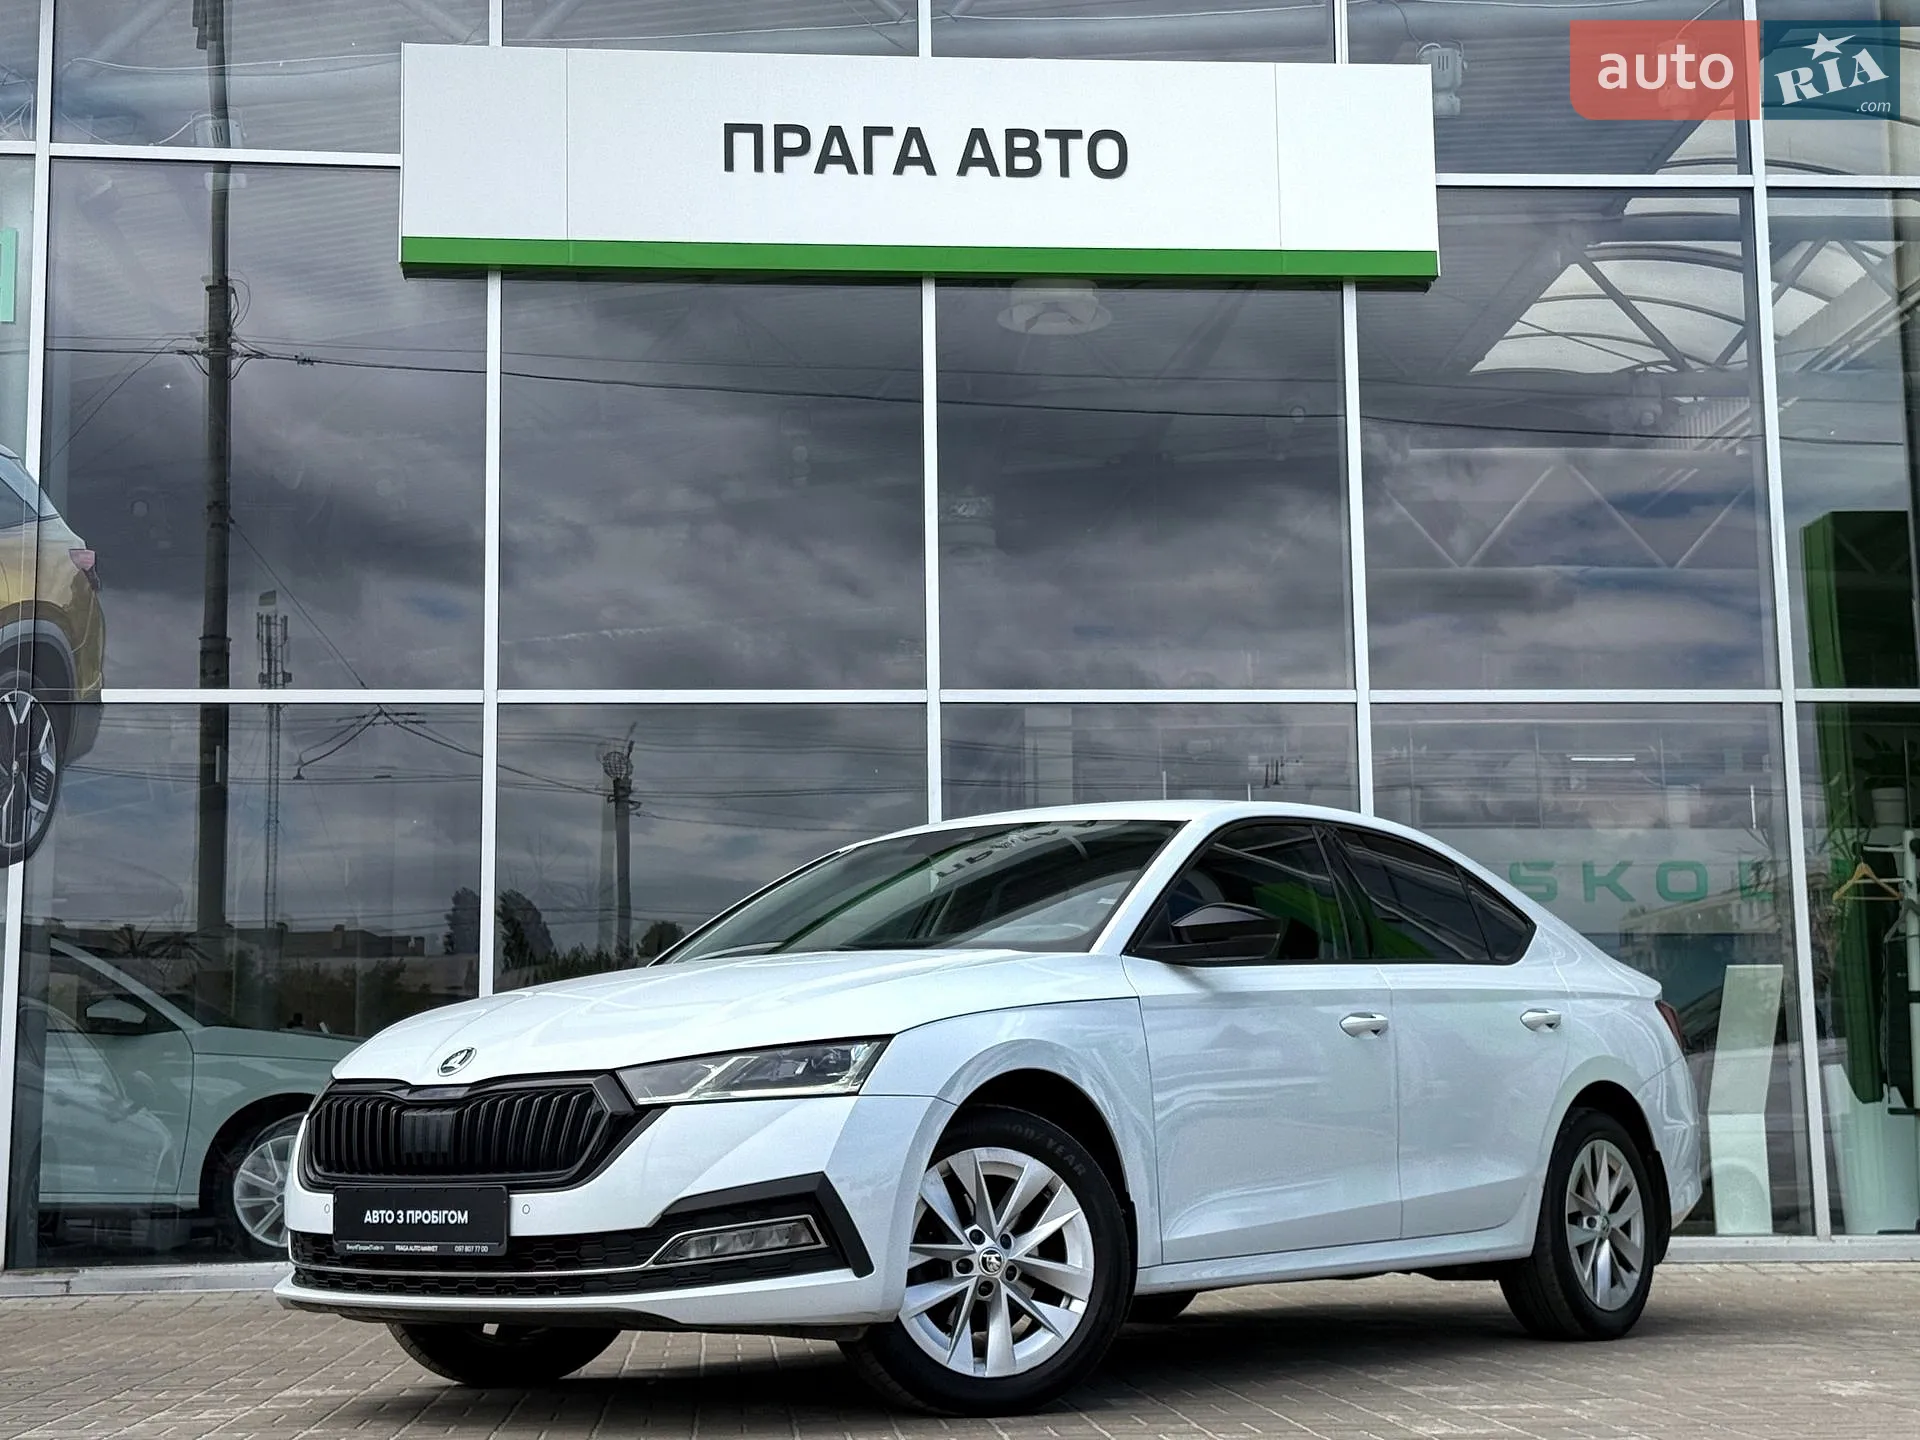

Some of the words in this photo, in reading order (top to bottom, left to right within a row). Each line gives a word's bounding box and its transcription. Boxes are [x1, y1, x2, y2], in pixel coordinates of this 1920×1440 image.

[723, 122, 937, 177] ПРАГА
[956, 127, 1129, 180] АВТО
[363, 1209, 395, 1224] АВТО
[406, 1209, 469, 1224] ПРОБІГОМ
